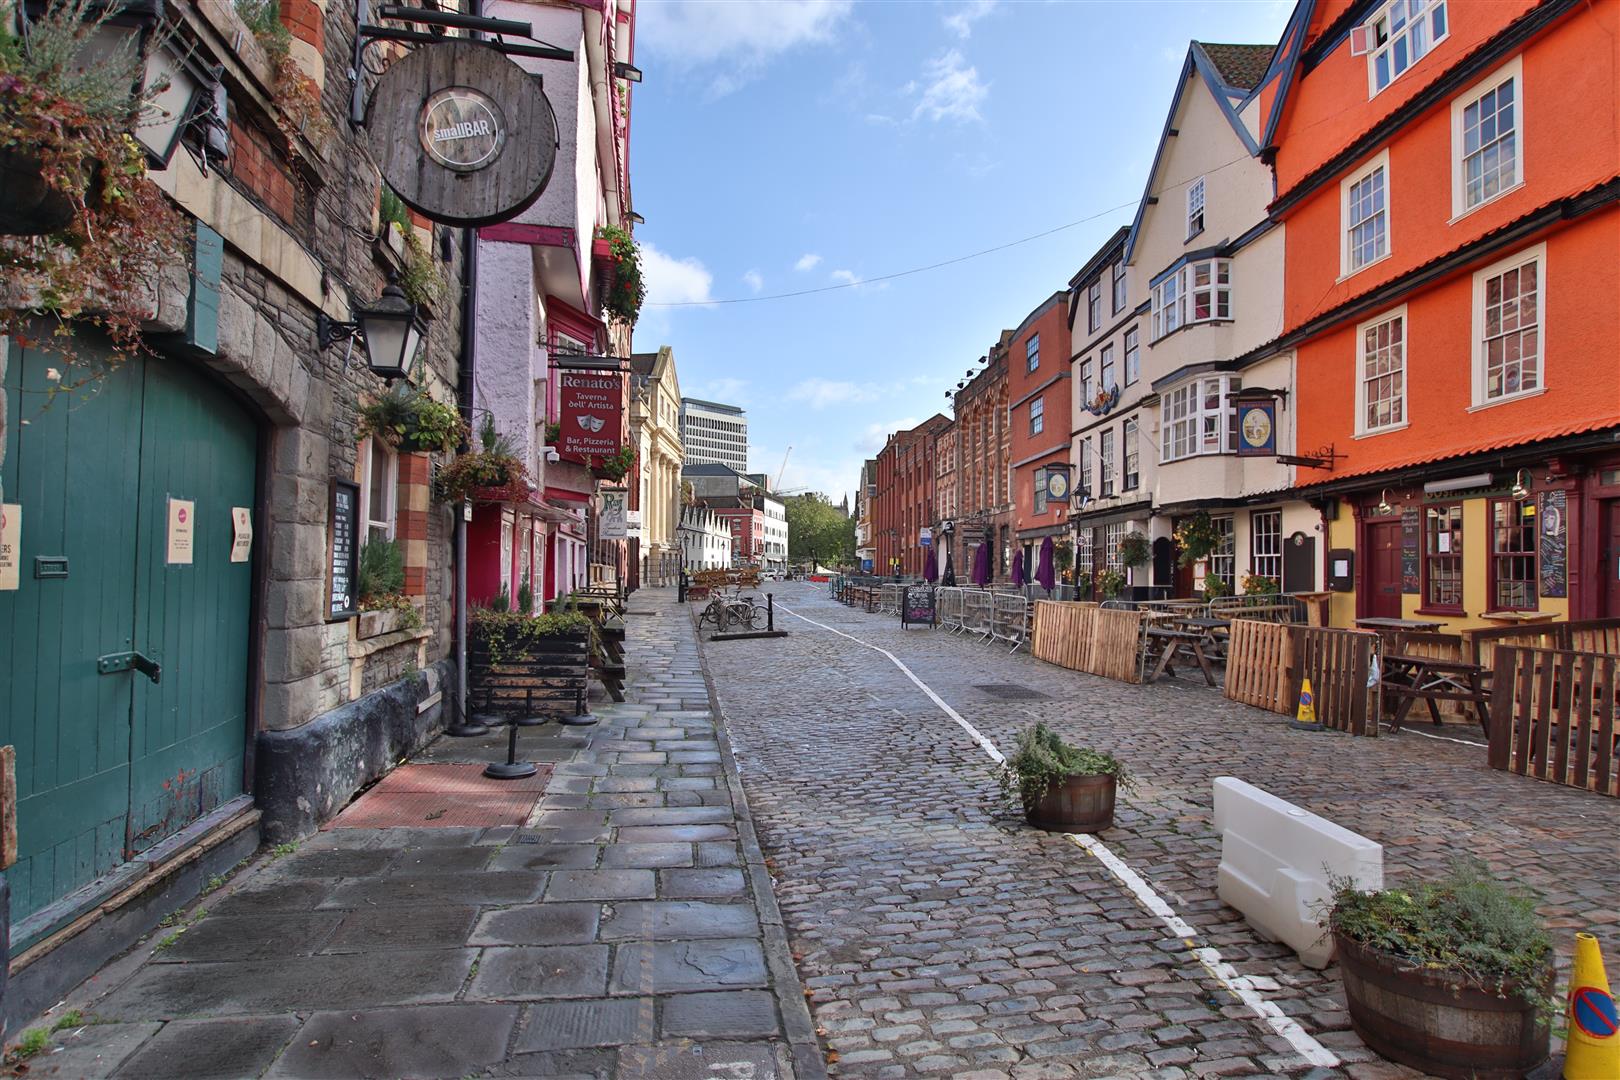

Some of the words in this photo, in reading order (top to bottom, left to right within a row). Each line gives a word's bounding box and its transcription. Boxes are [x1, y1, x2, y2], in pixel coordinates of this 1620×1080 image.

[433, 120, 490, 140] smallBAR
[562, 375, 620, 390] Renato's
[576, 392, 607, 401] Taverna
[588, 401, 614, 410] Artista
[583, 437, 614, 446] Pizzeria
[565, 445, 571, 453] &
[573, 445, 615, 454] Restaurant
